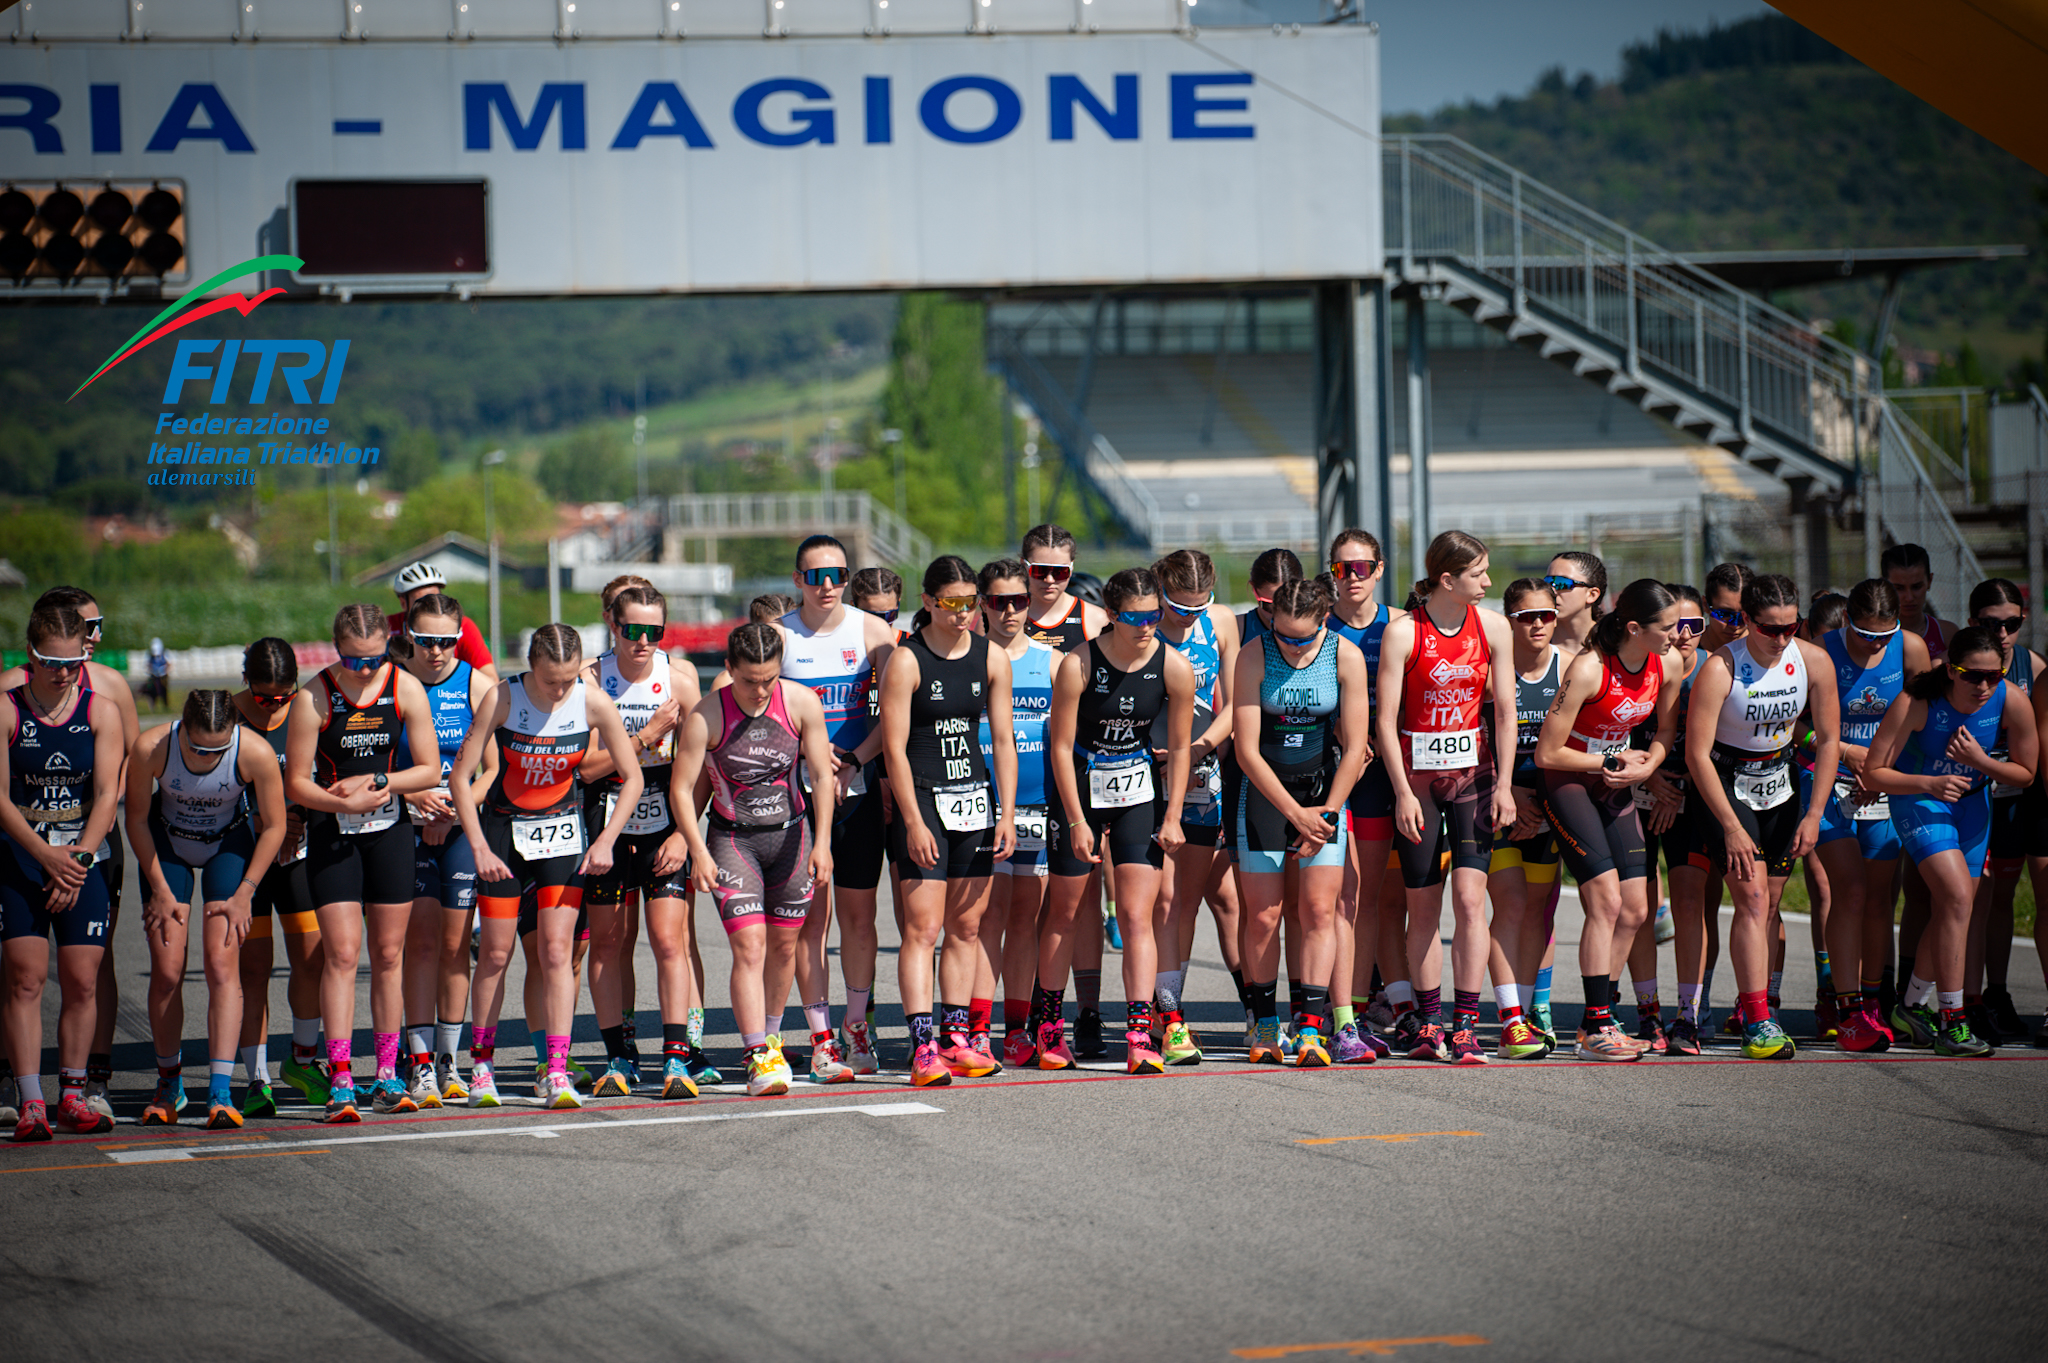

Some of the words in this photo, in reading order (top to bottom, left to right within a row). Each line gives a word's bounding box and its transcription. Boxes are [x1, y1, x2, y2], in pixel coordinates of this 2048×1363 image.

[462, 72, 1258, 152] MAGIONE
[822, 682, 862, 705] DDS
[1277, 687, 1321, 706] MCDOWELL
[1424, 687, 1475, 705] PASSONE
[1552, 680, 1571, 716] 482
[1760, 686, 1798, 698] MERLO
[1284, 706, 1310, 715] ITA
[1431, 706, 1463, 726] ITA
[1745, 700, 1798, 721] RIVARA
[1284, 716, 1317, 724] ROSSI
[1754, 721, 1786, 737] ITA
[340, 733, 390, 748] OBERHOFER
[1103, 726, 1135, 741] ITA
[353, 746, 374, 757] ITA
[510, 742, 533, 753] EROI
[534, 746, 552, 754] DEL
[554, 743, 579, 754] PIAVE
[941, 736, 970, 757] ITA
[1428, 736, 1471, 754] 480
[520, 755, 568, 771] MASO
[748, 746, 792, 767] MINERVA
[523, 769, 555, 786] ITA
[946, 758, 972, 780] DDS
[1106, 770, 1145, 793] 477
[1750, 773, 1786, 797] 484
[43, 785, 72, 799] ITA
[48, 799, 80, 812] SGR
[950, 796, 986, 817] 476
[529, 822, 575, 844] 473
[733, 902, 764, 916] GMA
[774, 906, 806, 918] GMA
